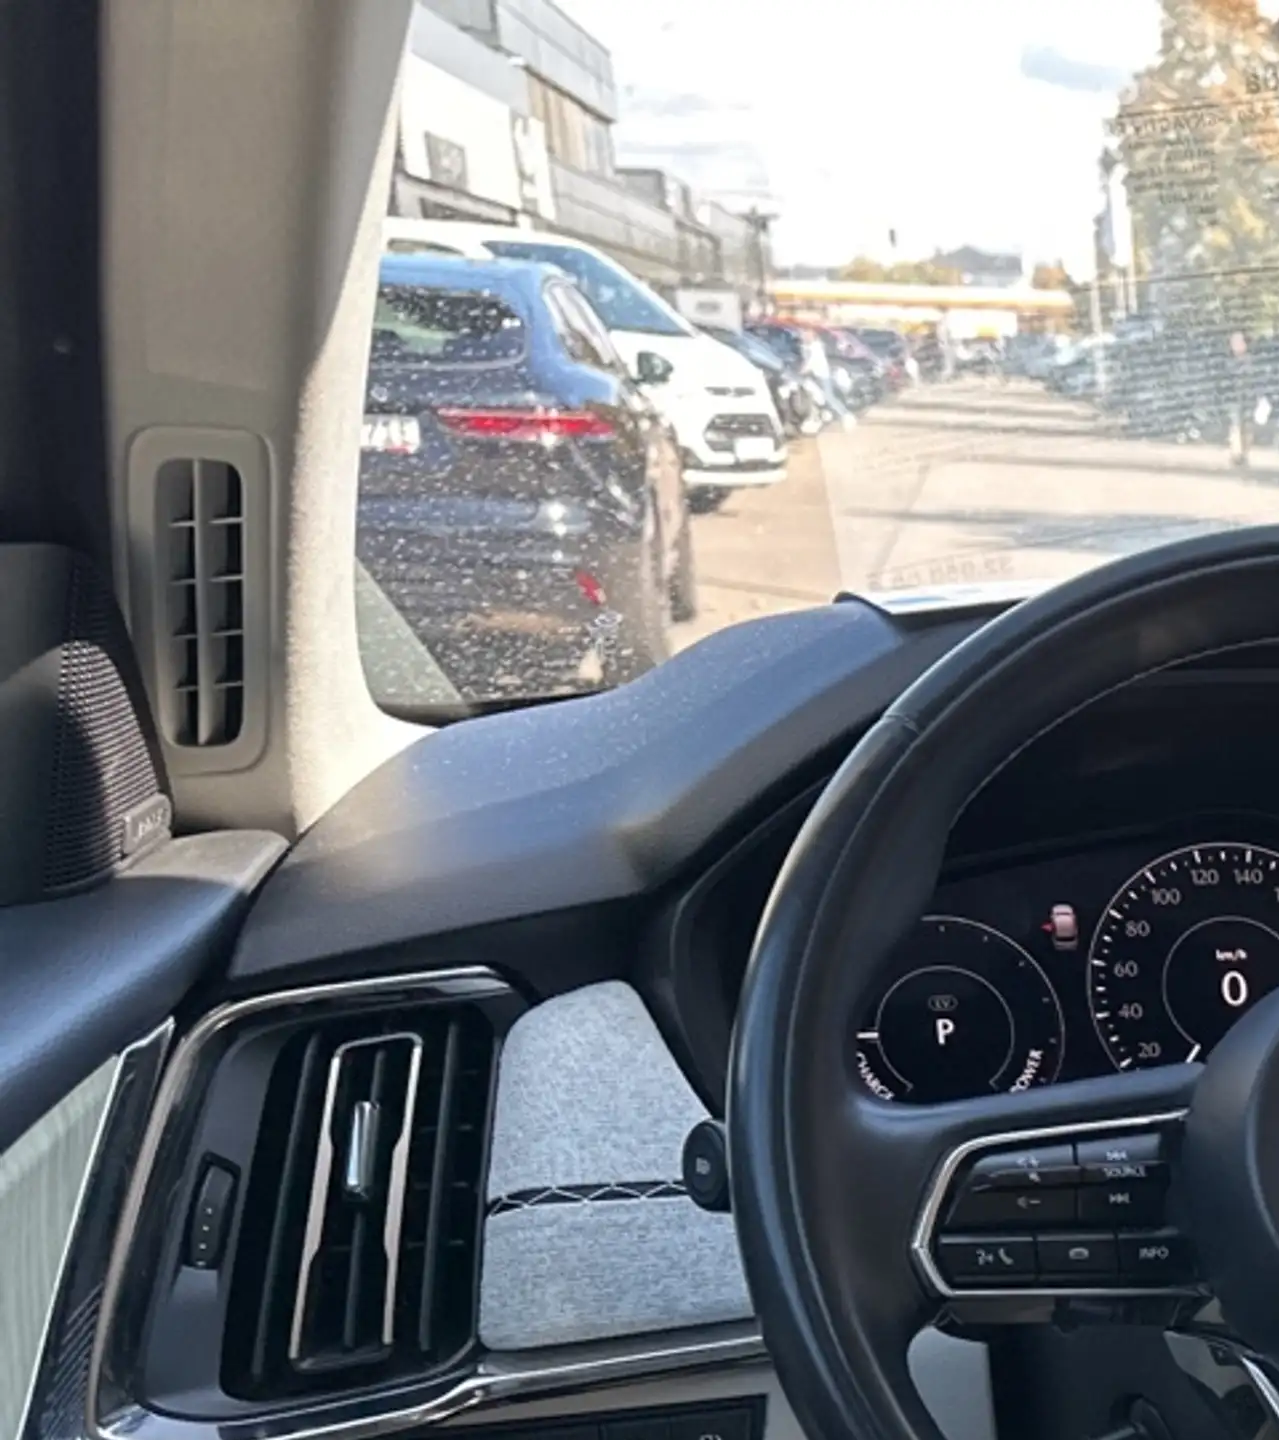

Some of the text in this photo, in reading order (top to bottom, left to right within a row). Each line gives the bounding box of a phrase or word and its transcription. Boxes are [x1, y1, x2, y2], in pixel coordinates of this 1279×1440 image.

[1191, 869, 1219, 885] 120
[1233, 869, 1263, 885] 140
[1152, 889, 1181, 904] 100
[1125, 920, 1150, 937] 80
[1114, 961, 1138, 978] 60
[1220, 970, 1248, 1007] 0
[1118, 1003, 1143, 1019] 40
[936, 1018, 955, 1046] P
[1138, 1042, 1161, 1058] 20
